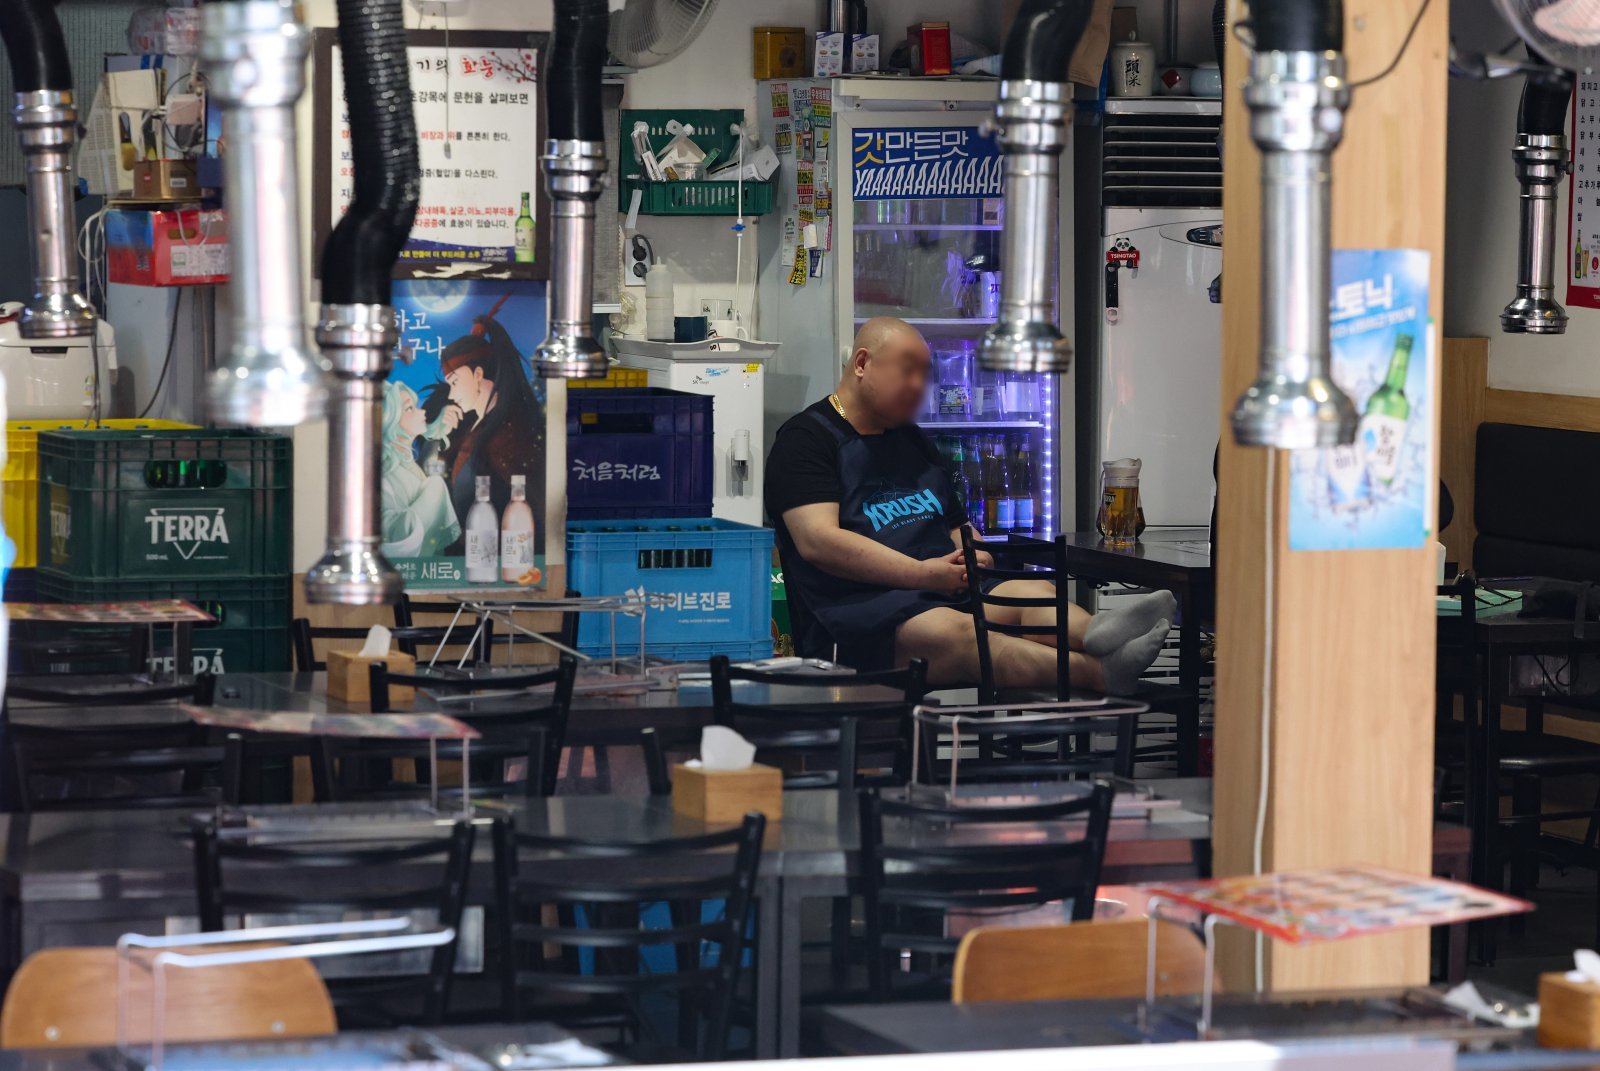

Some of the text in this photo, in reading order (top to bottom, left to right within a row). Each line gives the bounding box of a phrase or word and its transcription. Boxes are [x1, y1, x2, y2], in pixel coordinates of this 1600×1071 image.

[462, 57, 494, 79] 효능
[1581, 82, 1600, 90] 돼지고
[454, 92, 483, 104] 문헌을
[489, 93, 529, 104] 살펴보면
[855, 131, 969, 167] 갓만든맛
[465, 169, 498, 179] 다스린다.
[572, 459, 661, 481] 처음처럼
[863, 488, 944, 532] KRUSH
[145, 508, 230, 545] TERRA
[421, 562, 453, 580] 새로
[145, 649, 225, 677] TERA
